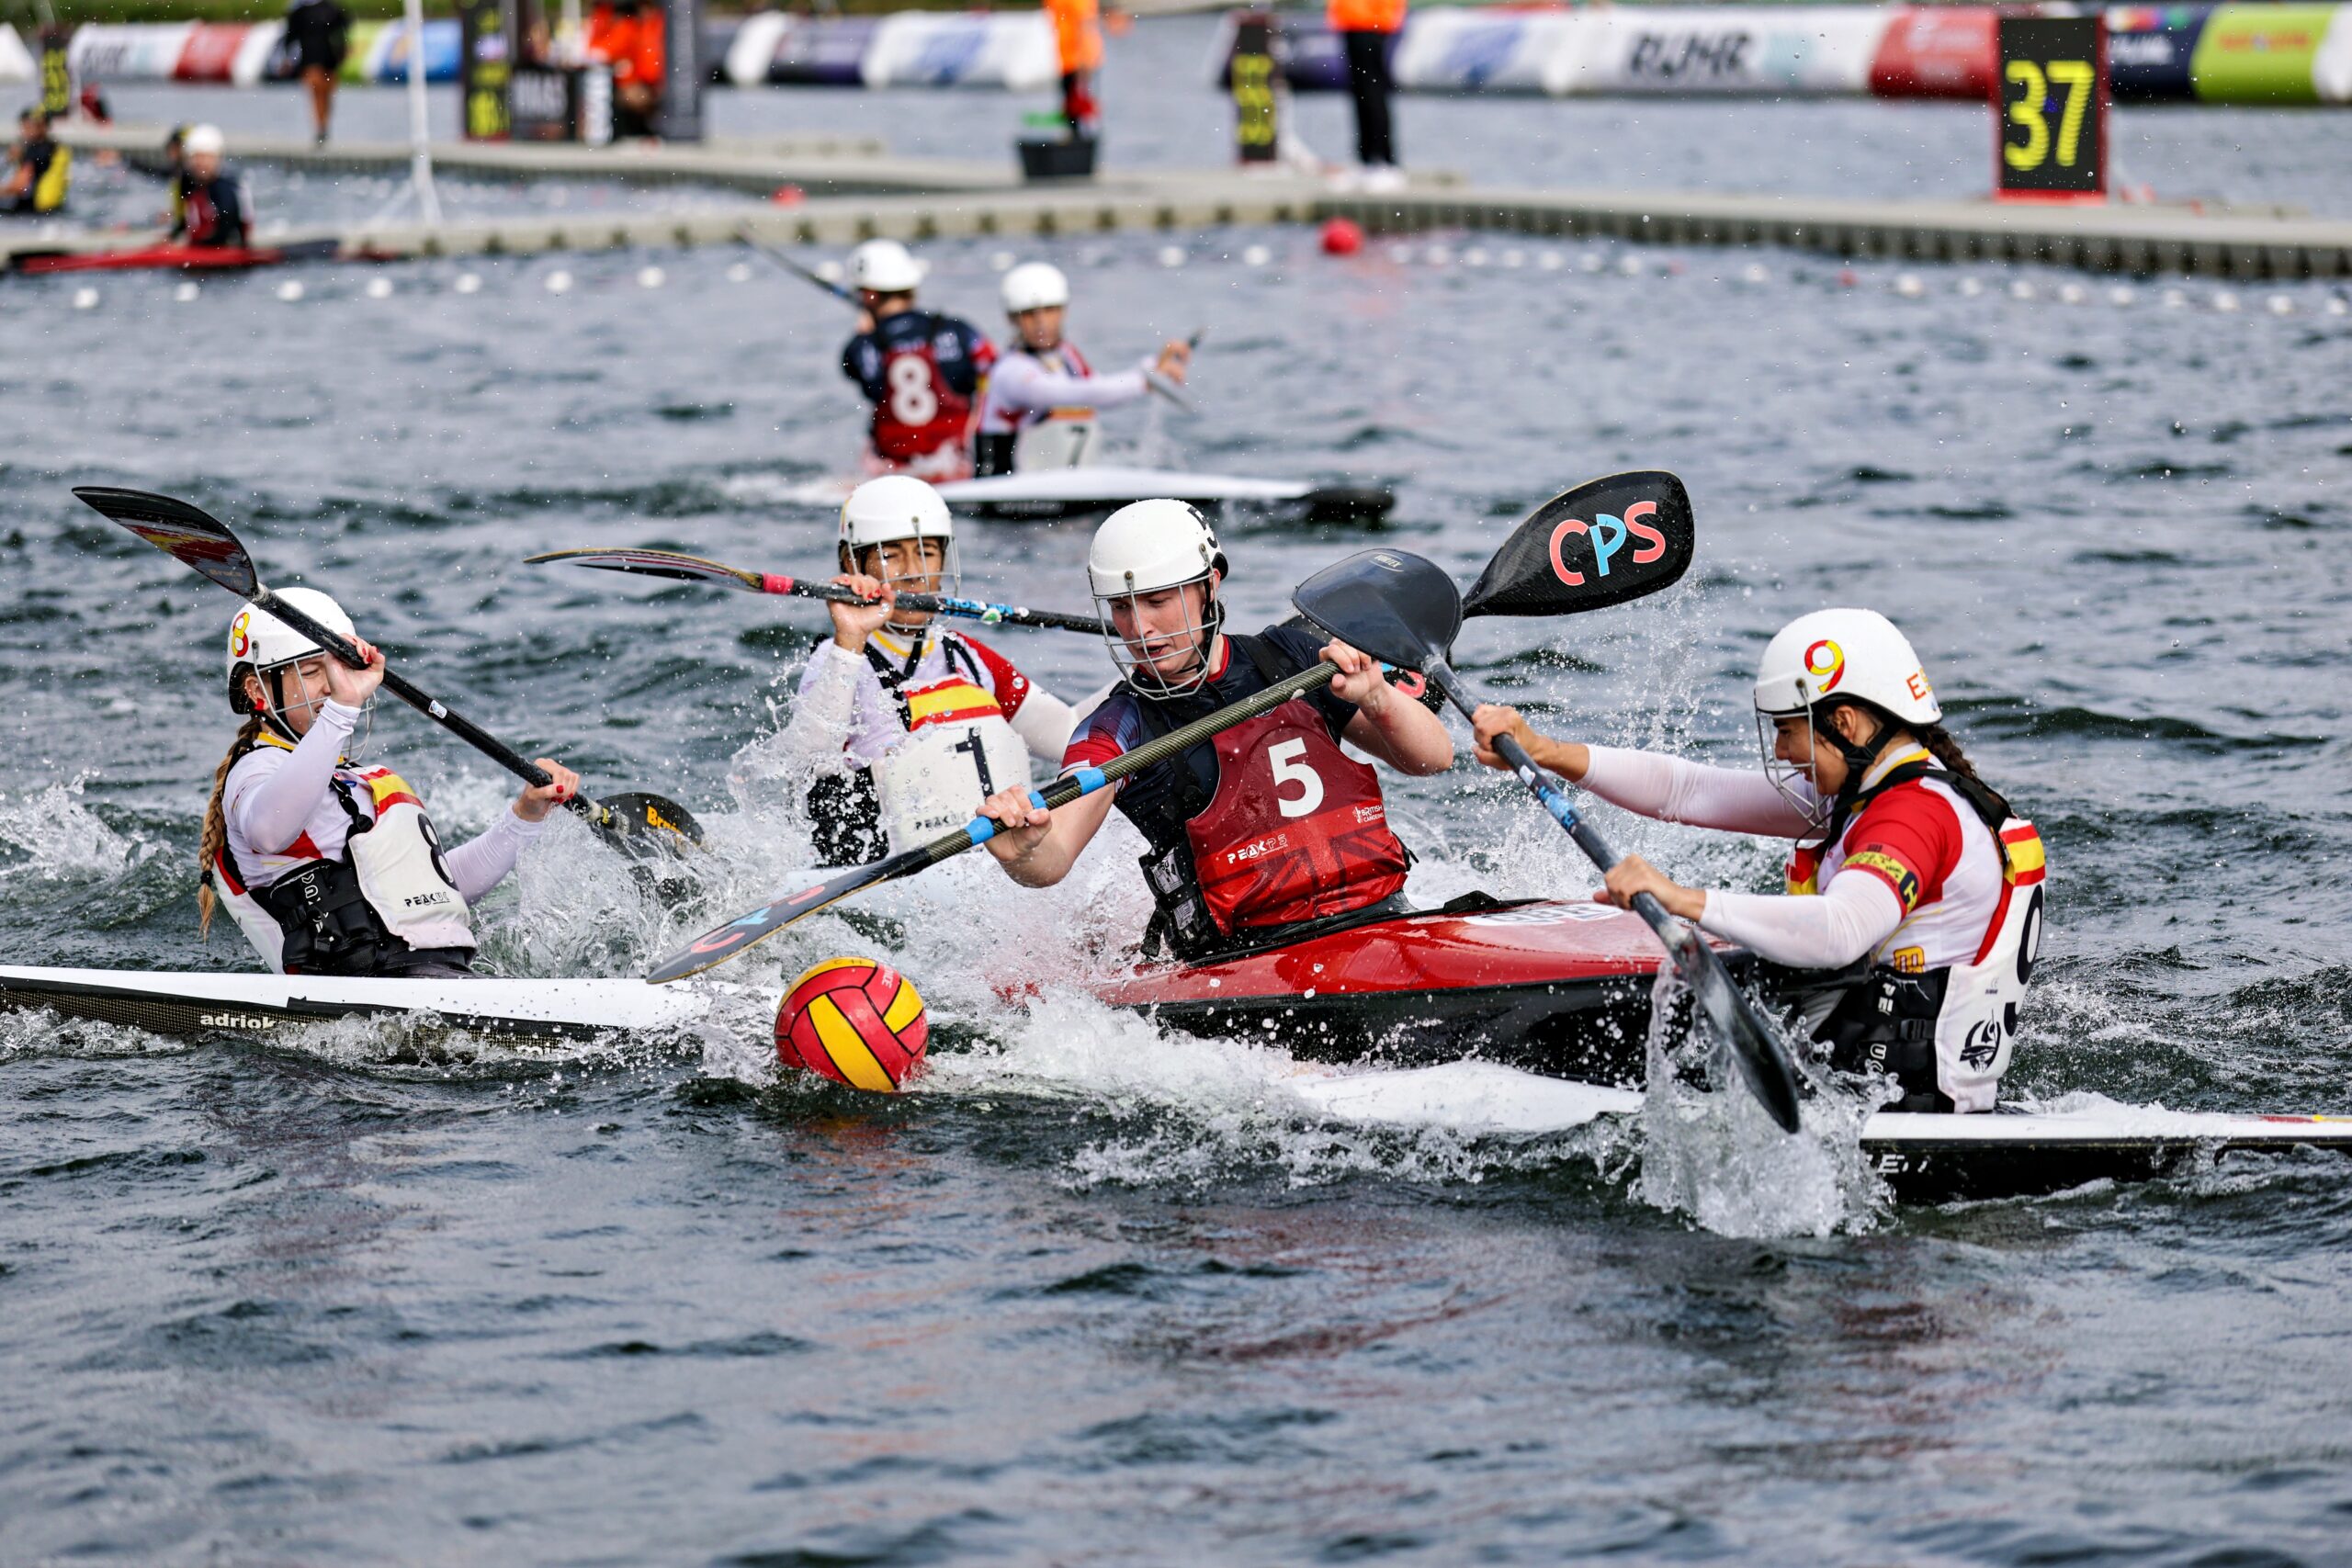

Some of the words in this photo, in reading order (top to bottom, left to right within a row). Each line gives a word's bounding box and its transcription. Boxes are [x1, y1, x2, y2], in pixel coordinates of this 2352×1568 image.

[2004, 60, 2096, 171] 37
[888, 352, 939, 427] 8
[1066, 424, 1091, 469] 7
[1549, 501, 1666, 586] CPS
[232, 612, 250, 658] 8
[1804, 639, 1845, 694] 9
[955, 727, 995, 803] 1
[1267, 736, 1325, 818] 5
[417, 812, 459, 891] 8
